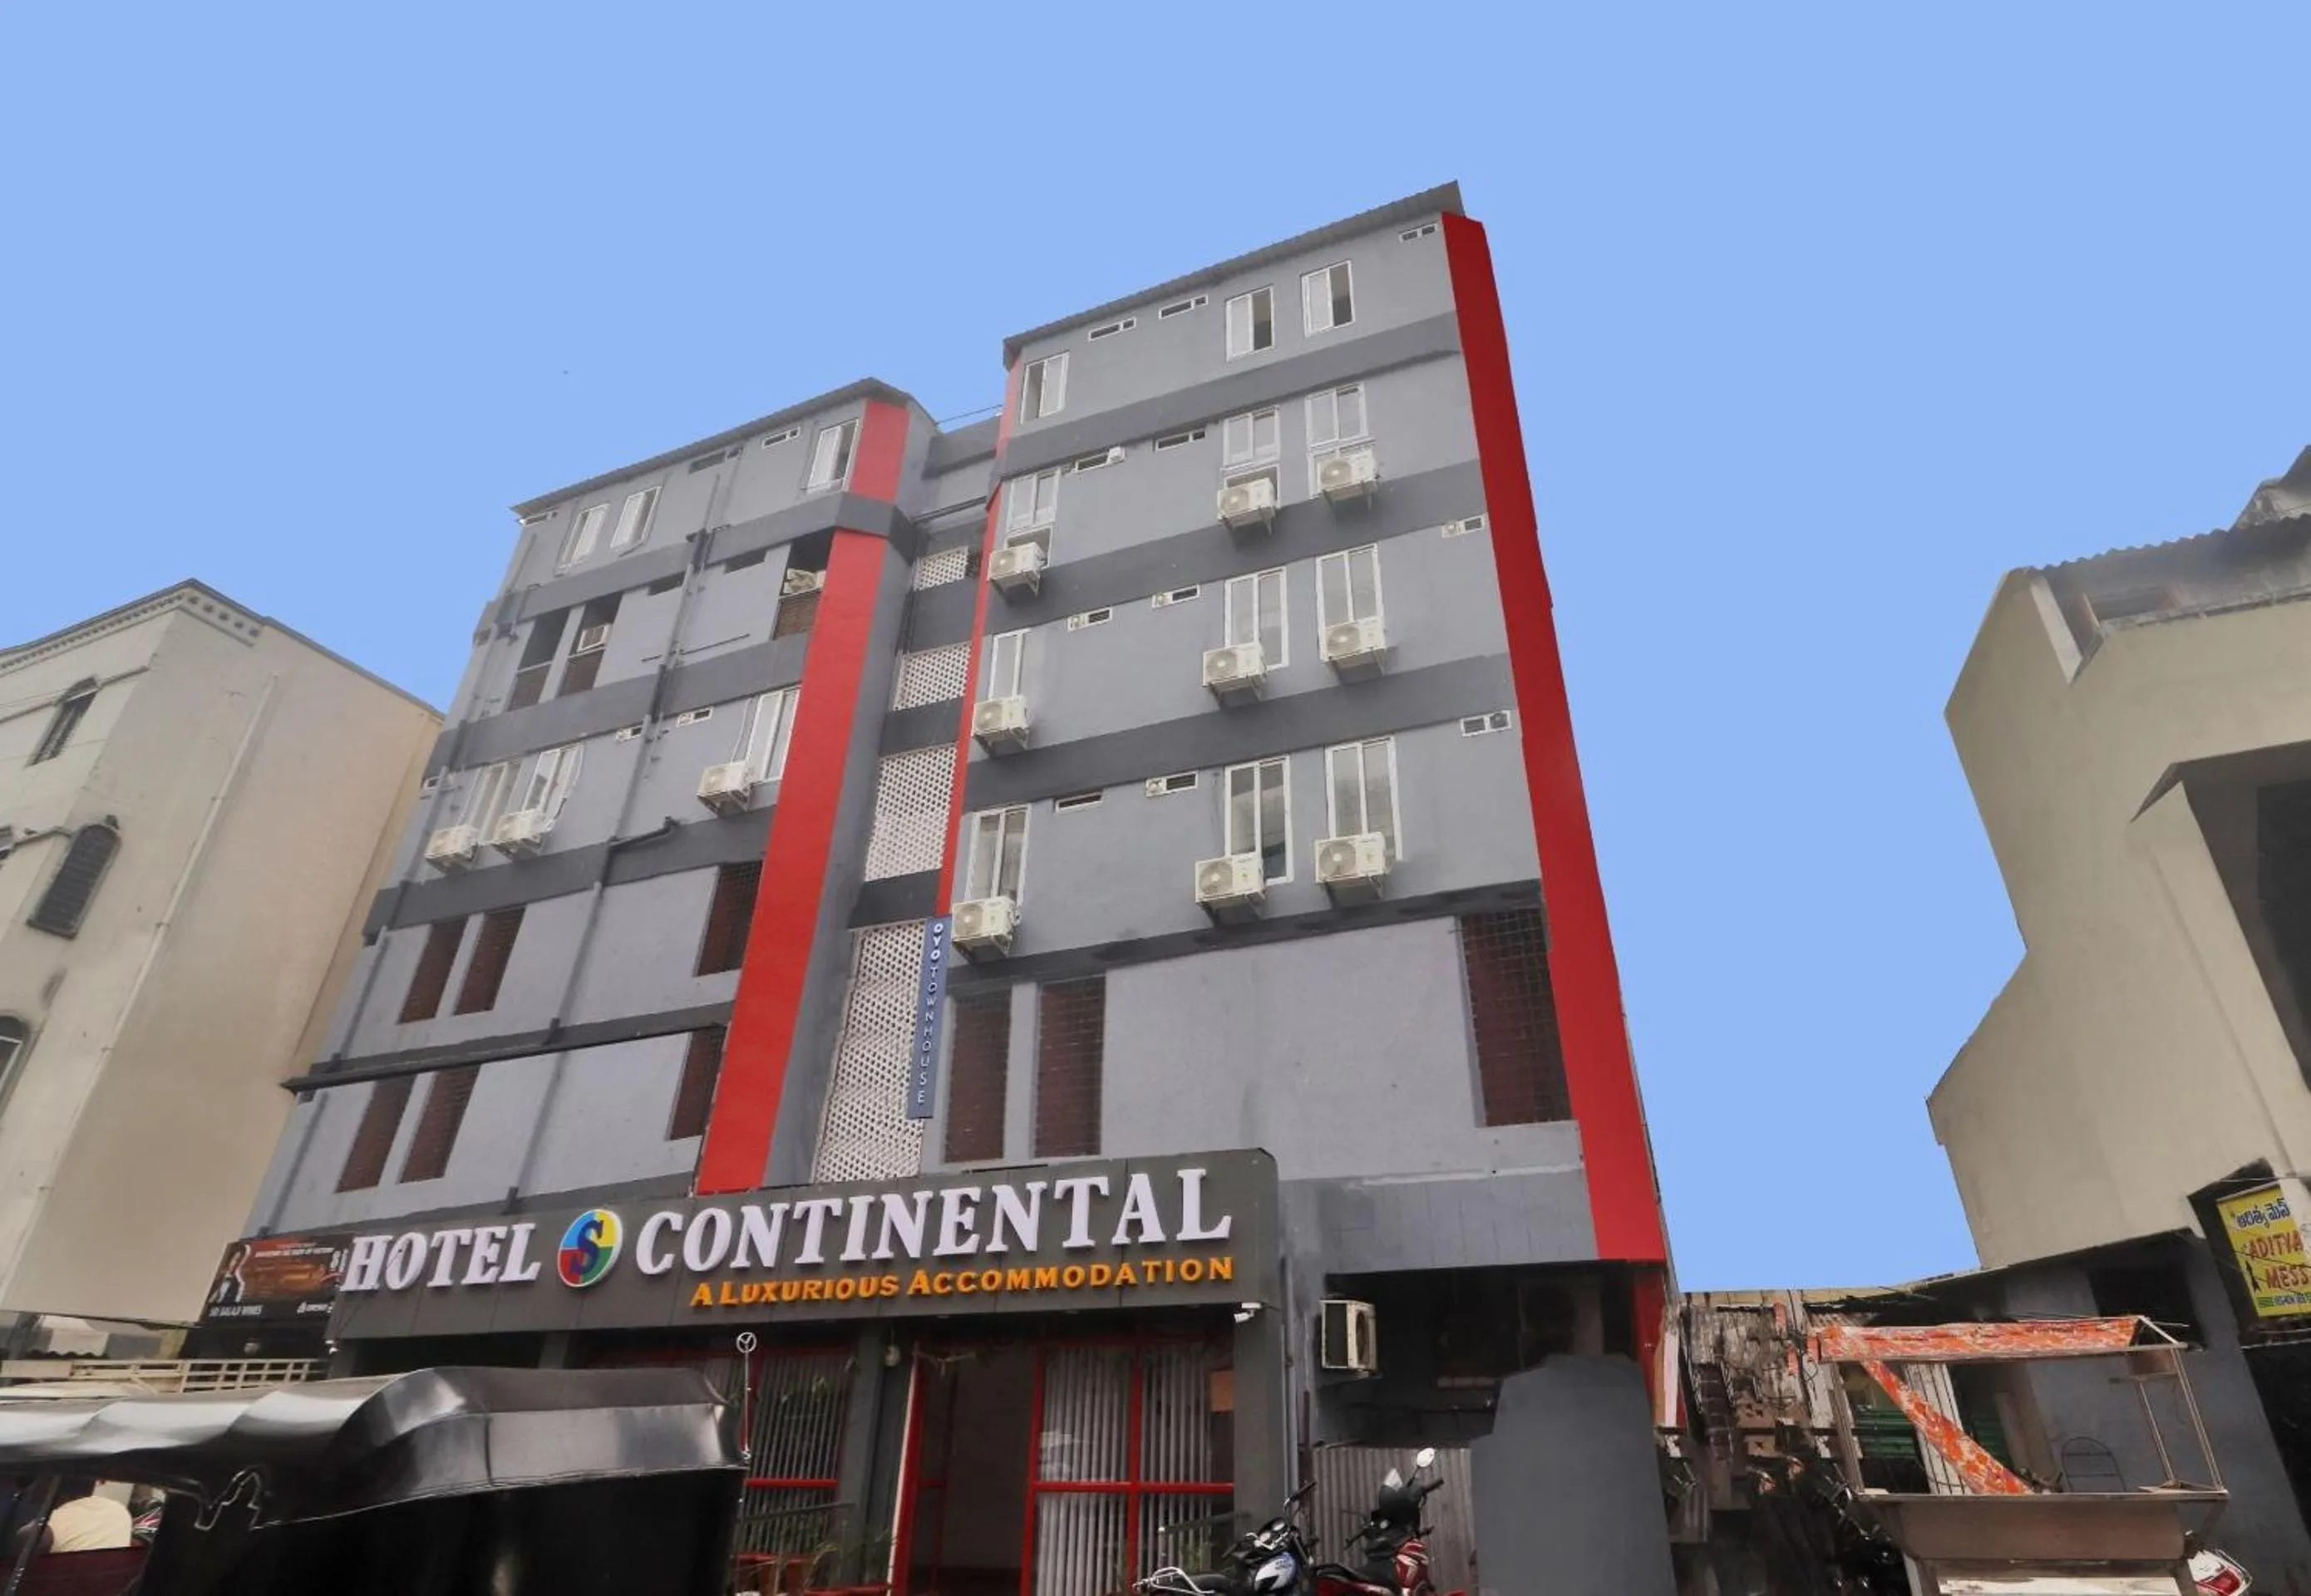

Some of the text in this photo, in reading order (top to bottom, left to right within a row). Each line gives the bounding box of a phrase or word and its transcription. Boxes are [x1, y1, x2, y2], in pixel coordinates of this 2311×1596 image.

[930, 923, 944, 960] OYO
[340, 1223, 542, 1293] HOTEL
[635, 1168, 1233, 1275] CONTINENTAL
[690, 1256, 1234, 1307] A LUXURIOUS ACCOMMODATION
[2266, 1266, 2309, 1289] MESS
